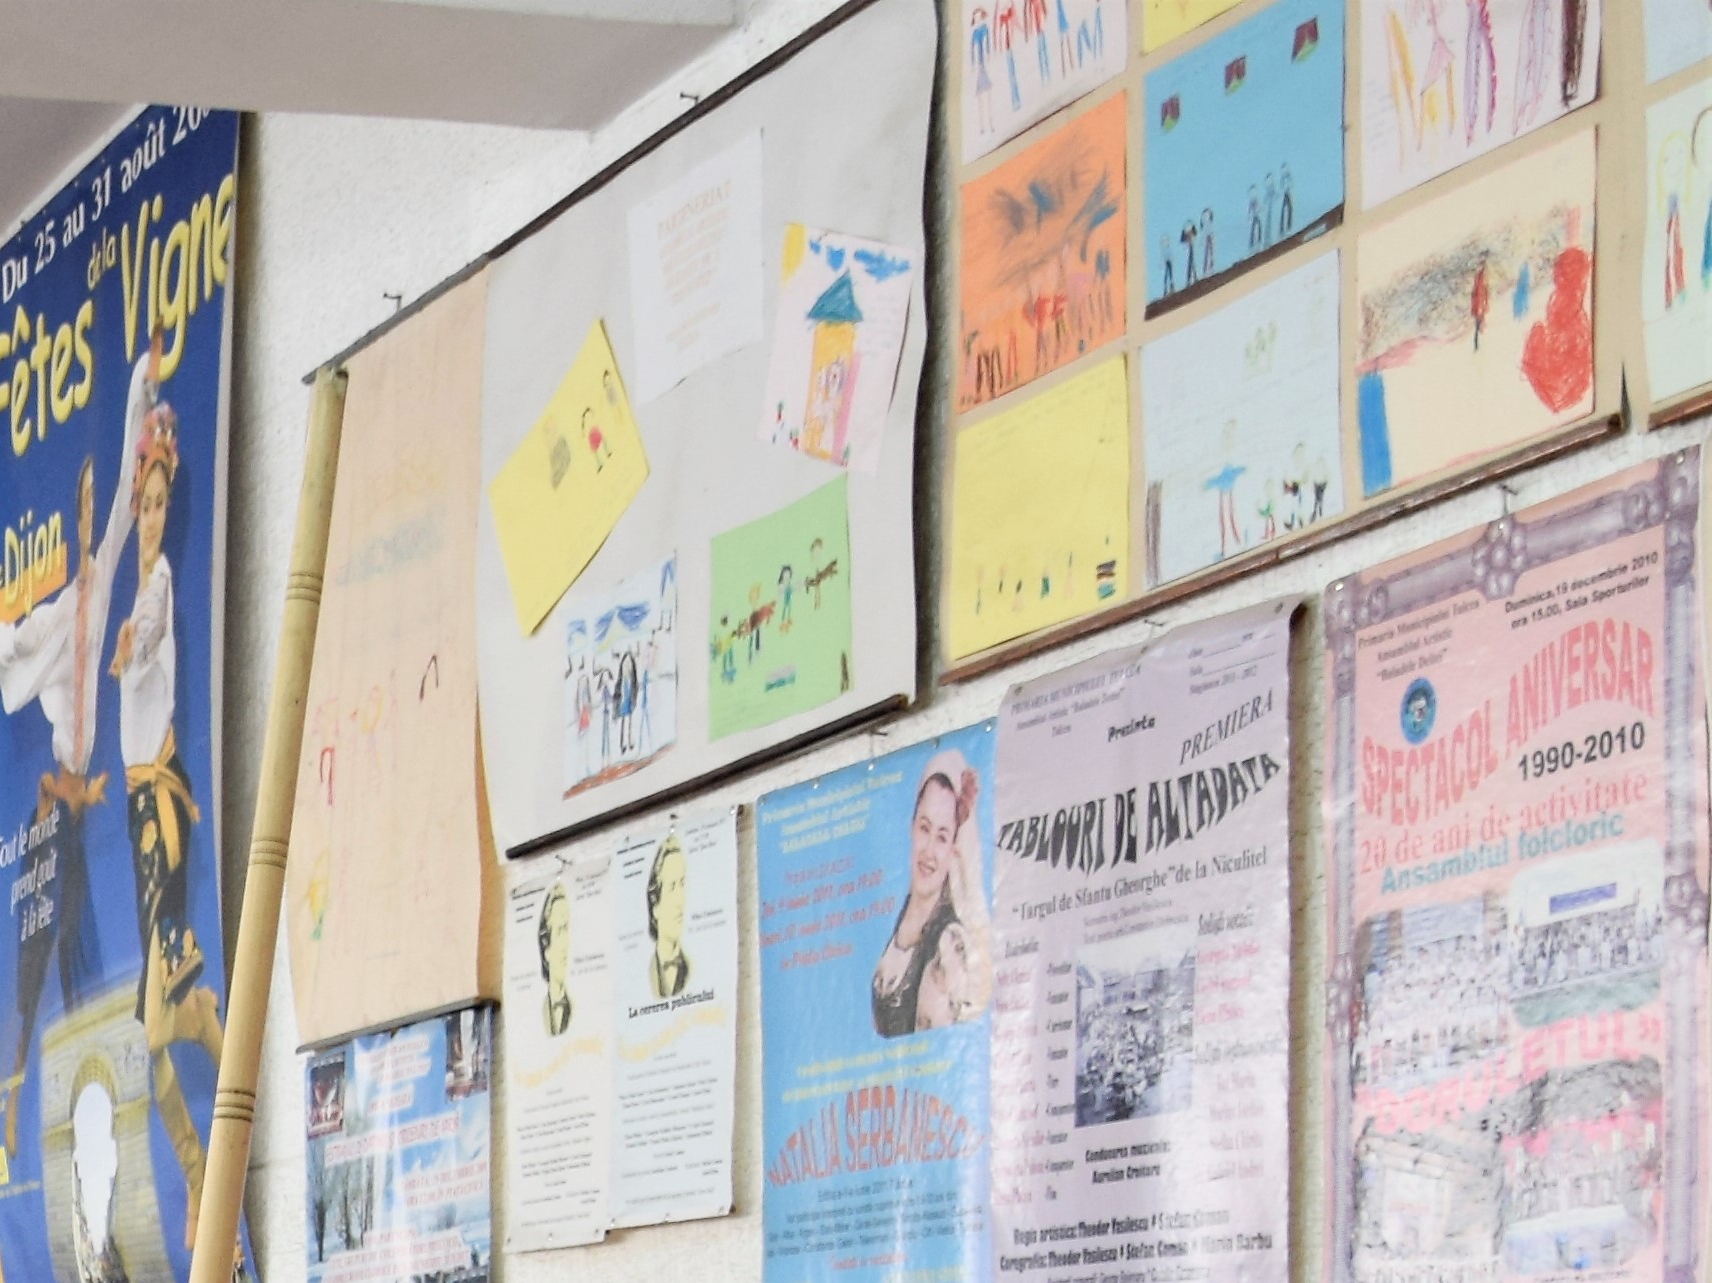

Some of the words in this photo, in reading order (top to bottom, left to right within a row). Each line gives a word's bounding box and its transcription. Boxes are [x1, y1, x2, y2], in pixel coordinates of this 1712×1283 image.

[2, 255, 27, 303] Du
[35, 219, 55, 275] 25
[63, 203, 85, 248] au
[92, 166, 111, 221] 31
[121, 117, 166, 193] août
[5, 510, 62, 615] Dijon
[1570, 565, 1627, 591] decembrie
[1632, 551, 1658, 571] 2010
[1511, 616, 1528, 629] ora
[1565, 596, 1588, 612] Sala
[1179, 687, 1273, 765] PREMIERA
[1362, 699, 1499, 826] SPECTACOL
[1504, 617, 1656, 761] ANIVERSAR
[1518, 721, 1646, 781] 1990-2010
[19, 824, 27, 857] le
[28, 800, 60, 850] monde
[997, 799, 1106, 877] TABLOURI
[1111, 788, 1137, 869] DE
[1146, 752, 1280, 854] ALTADATA
[1359, 837, 1387, 874] 20
[1395, 829, 1424, 864] de
[1433, 813, 1471, 854] ani
[1481, 805, 1511, 841] de
[1519, 774, 1648, 830] activitate
[1381, 841, 1511, 895] Ansamblul
[1517, 812, 1625, 861] folcloric
[10, 858, 38, 916] prend
[1196, 859, 1207, 879] la
[628, 1007, 639, 1019] La
[768, 1102, 841, 1188] NATALIA
